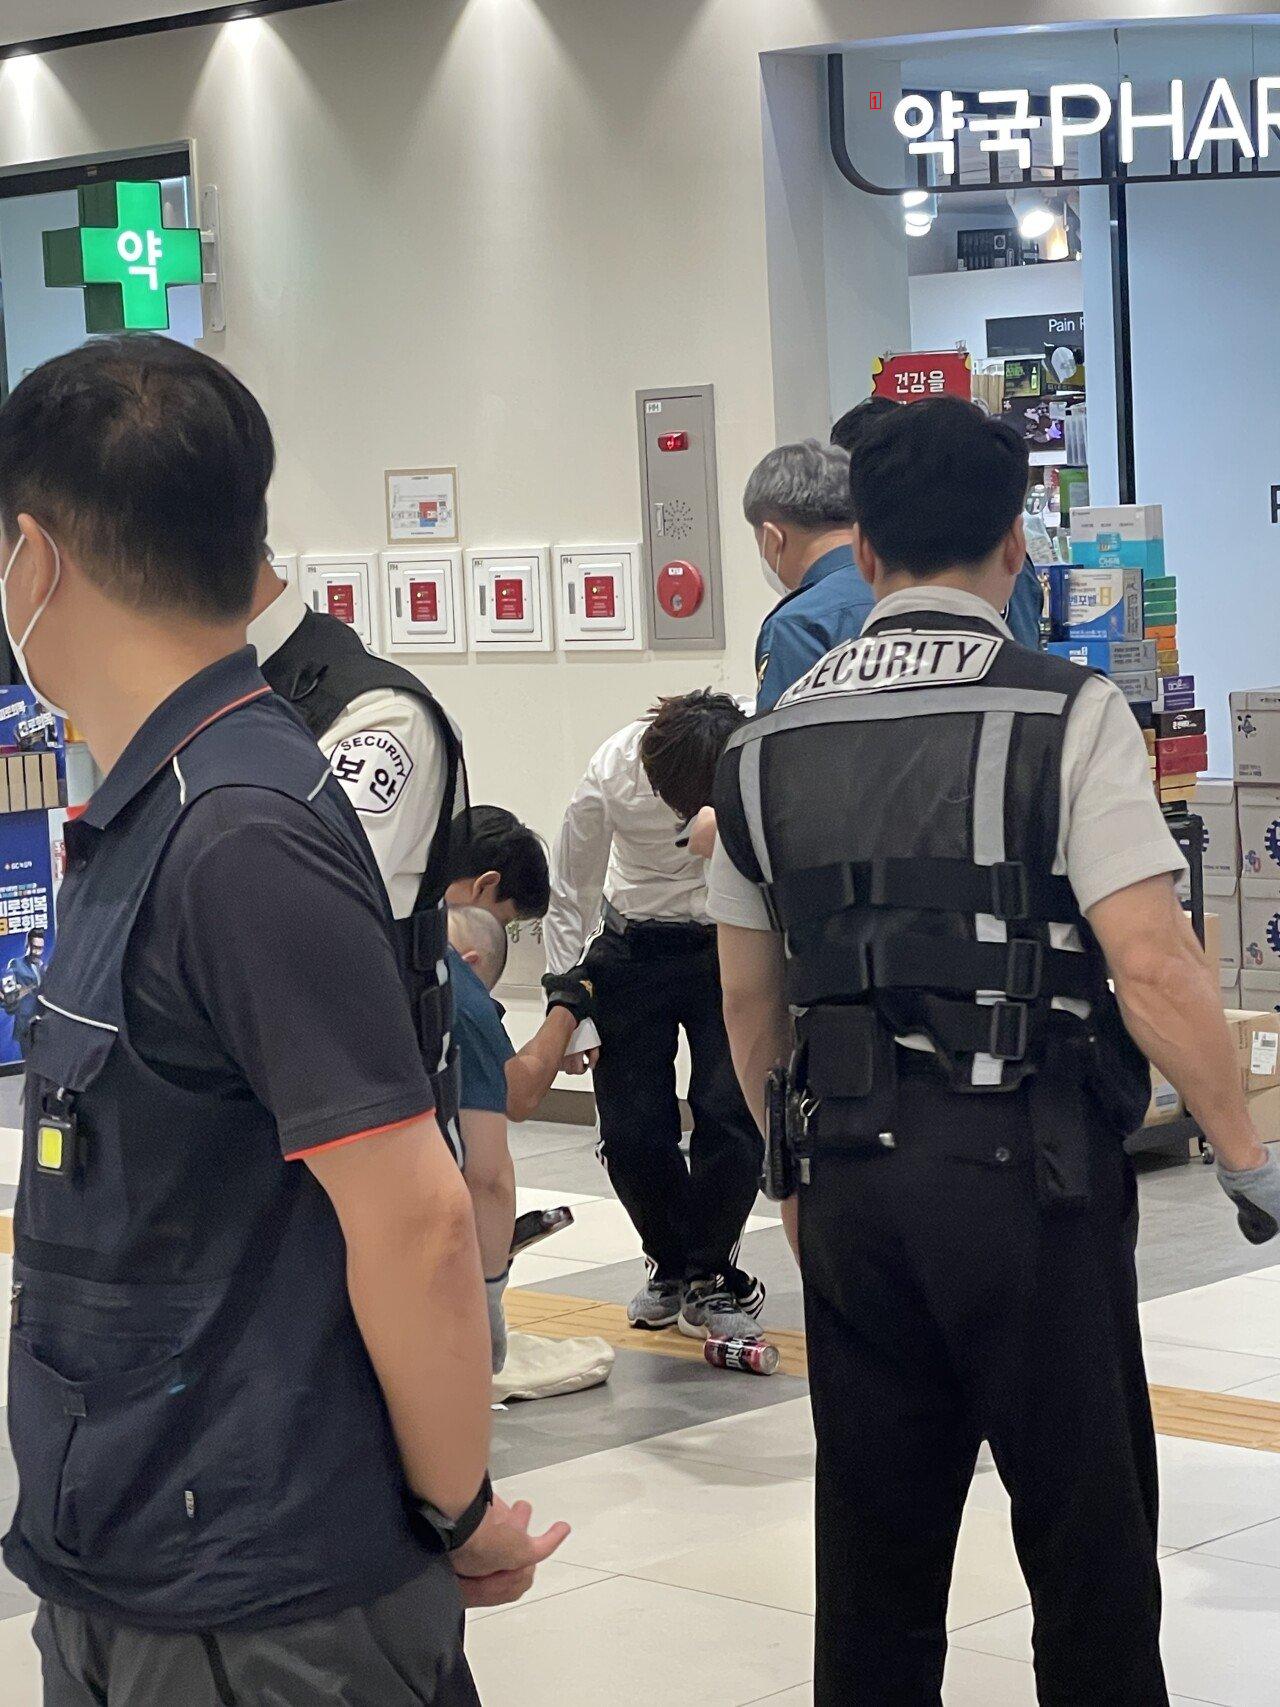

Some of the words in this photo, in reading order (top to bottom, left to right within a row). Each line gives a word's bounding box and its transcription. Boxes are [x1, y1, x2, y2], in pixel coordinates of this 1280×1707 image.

[893, 88, 1041, 174] 약국
[117, 230, 162, 291] 약
[1048, 318, 1075, 332] Pain
[894, 370, 945, 394] 건강을
[333, 754, 397, 804] 보안
[340, 735, 406, 777] SECURITY
